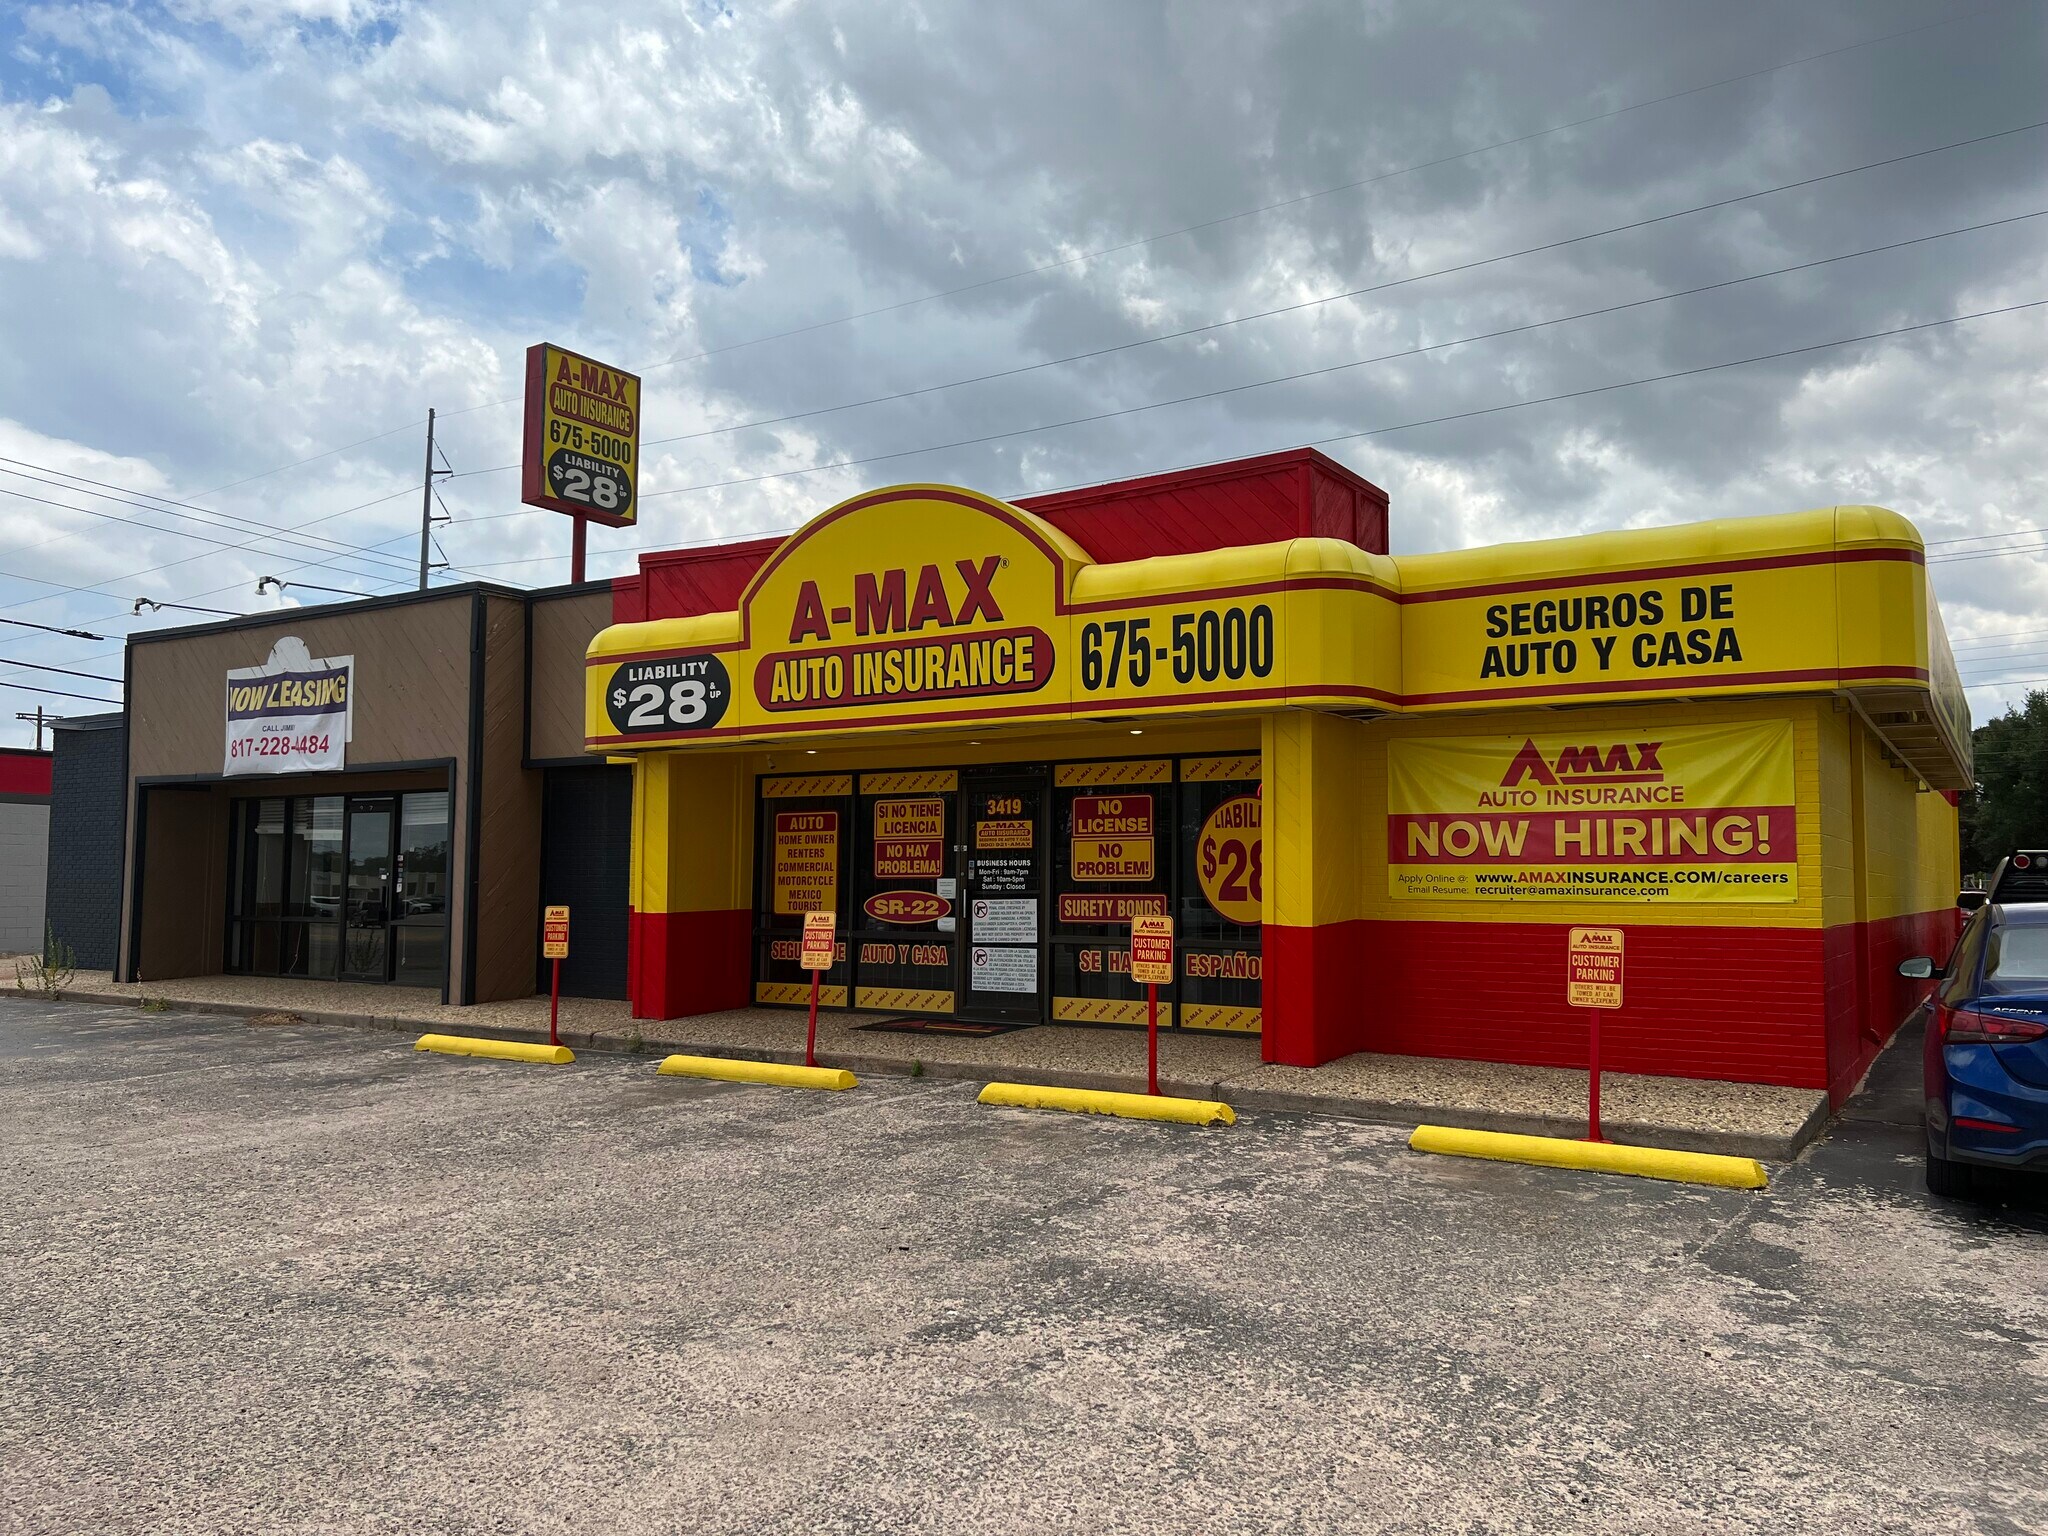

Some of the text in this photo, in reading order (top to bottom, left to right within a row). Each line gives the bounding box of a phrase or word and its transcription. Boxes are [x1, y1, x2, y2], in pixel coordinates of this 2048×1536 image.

[557, 356, 627, 404] A-MAX
[554, 387, 630, 432] AUTO INSURANCE
[551, 420, 631, 464] 675-5000
[565, 454, 620, 478] LIABILITY
[553, 465, 618, 509] $28
[789, 555, 1004, 643] A-MAX
[1486, 584, 1734, 638] SEGUROS DE
[1081, 604, 1273, 691] 675-5000
[1480, 627, 1743, 678] AUTO Y CASA
[629, 661, 708, 681] LIABILITY
[770, 636, 1034, 703] AUTO INSURANCE
[266, 675, 346, 708] LEASING
[710, 690, 721, 698] UP
[613, 680, 707, 727] $28
[1185, 762, 1203, 779] A-MAX
[1204, 761, 1222, 778] A-MAX
[1224, 760, 1242, 778] A-MAX
[1478, 785, 1684, 807] AUTO INSURANCE
[878, 803, 941, 819] SI NO TIENE
[987, 799, 1021, 814] 3419
[1097, 800, 1123, 815] NO
[790, 816, 824, 830] AUTO
[884, 820, 937, 834] LICENCIA
[1078, 817, 1148, 833] LICENSE
[778, 834, 834, 845] HOME OWNER
[1407, 815, 1771, 857] NOW HIRING!
[787, 848, 825, 859] RENTERS
[886, 844, 929, 858] NO HAY
[1098, 843, 1123, 858] NO
[778, 861, 834, 872] COMMERCIAL
[877, 859, 940, 874] PROBLEMA!
[1077, 861, 1149, 876] PROBLEM!
[778, 875, 834, 886] MOTORCYCLE
[1398, 874, 1423, 884] Apply
[1426, 874, 1455, 883] Online
[1475, 871, 1788, 884] www.AMAXINSURANCE.COM/careers
[788, 889, 821, 900] MEXICO
[1407, 885, 1669, 896] Email Resume: recruiter@amaxinsurance.com
[787, 900, 822, 911] TOURIST
[874, 899, 939, 915] SR-22
[1064, 900, 1162, 917] SURETY BONDS
[805, 931, 832, 940] CUSTOMER
[1134, 938, 1170, 950] CUSTOMER
[807, 940, 829, 950] PARKING
[861, 944, 949, 966] AUTO Y CASA
[1079, 950, 1101, 972] SE
[1137, 949, 1167, 961] PARKING
[1572, 954, 1620, 968] CUSTOMER
[1186, 951, 1262, 980] ESPAÑO
[1576, 968, 1615, 981] PARKING
[1058, 1000, 1074, 1017] A-MAX
[1076, 1001, 1093, 1018] A-MAX
[1094, 1002, 1111, 1019] A-MAX
[1112, 1003, 1130, 1020] A-MAX
[1131, 1004, 1149, 1021] A-MAX
[1185, 1007, 1203, 1024] A-MAX
[1204, 1008, 1223, 1026] A-MAX
[1992, 1006, 2043, 1016] ACCENT
[1224, 1010, 1243, 1027] A-MAX
